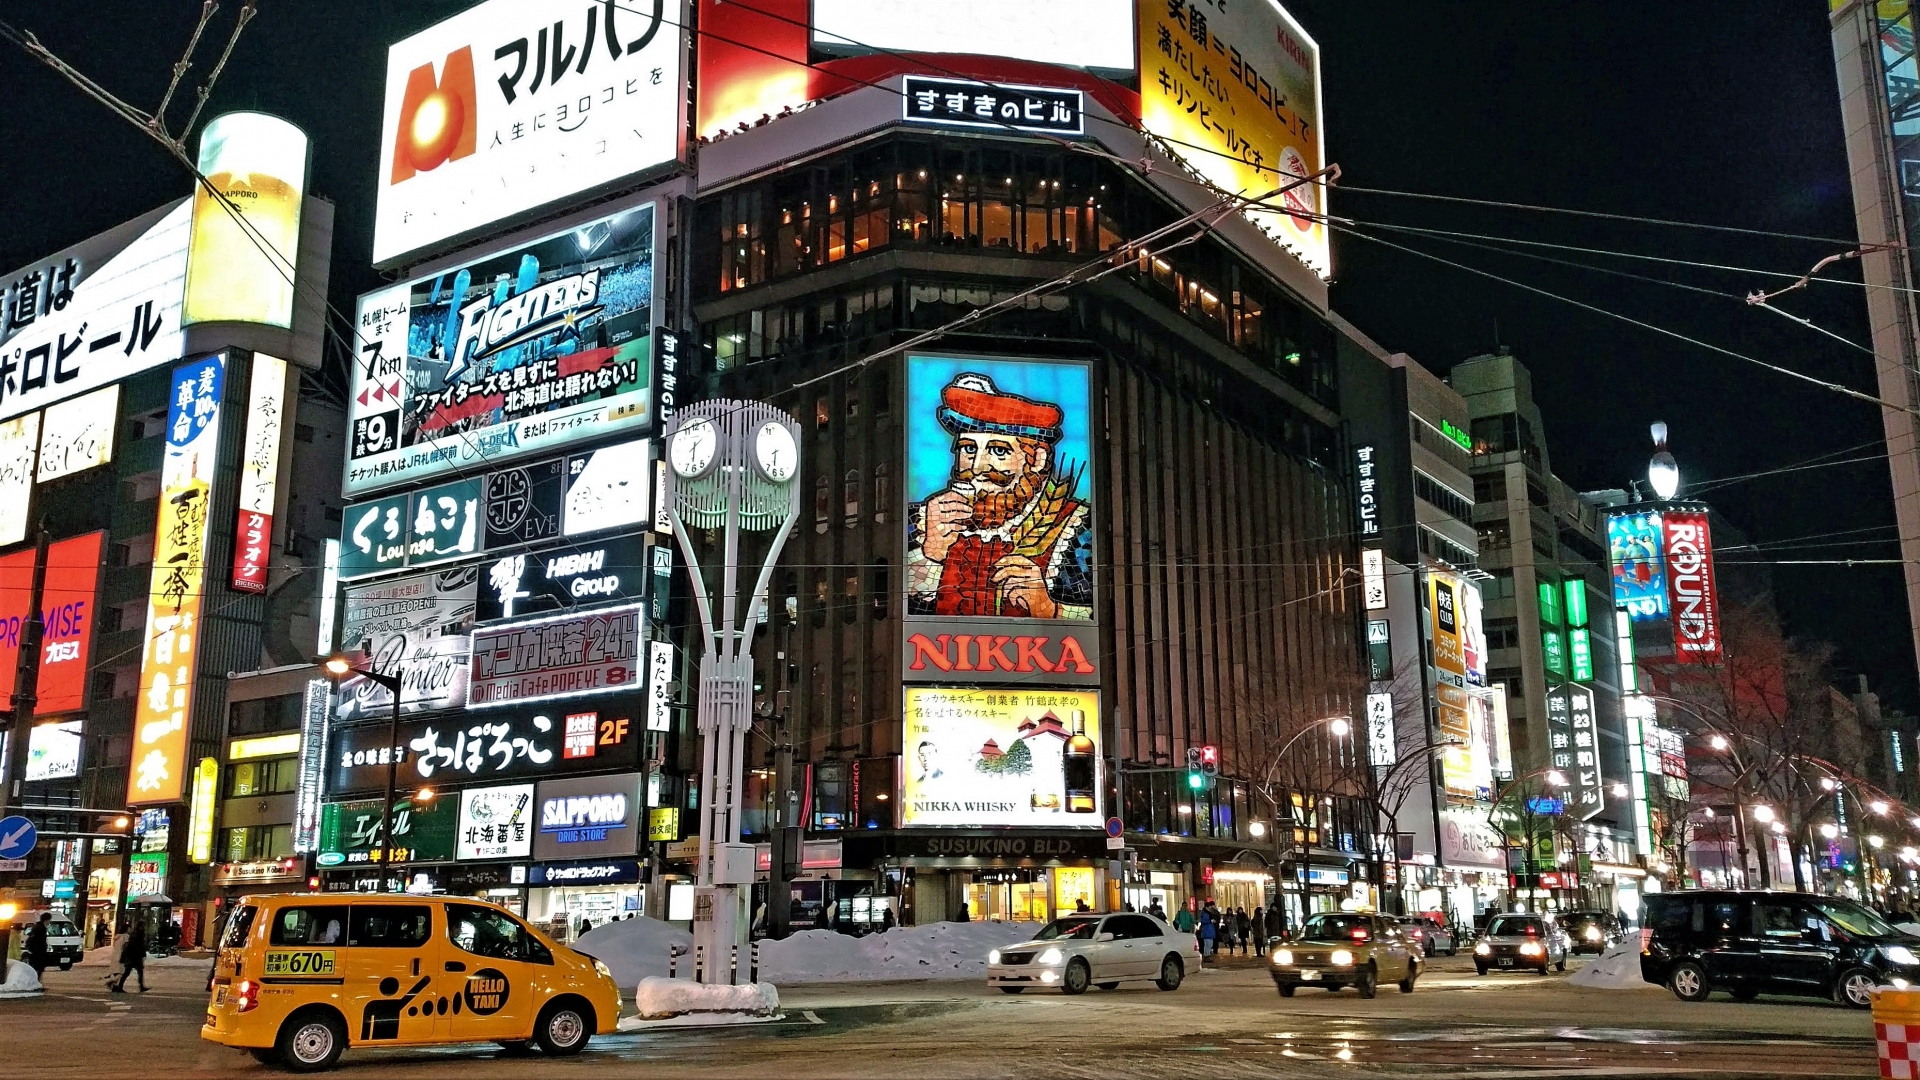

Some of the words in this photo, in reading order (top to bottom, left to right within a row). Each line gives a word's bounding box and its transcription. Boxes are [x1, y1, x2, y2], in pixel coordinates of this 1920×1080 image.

[1276, 25, 1310, 73] KIRIN
[915, 90, 1071, 123] すすきのビル
[0, 258, 78, 334] 道は
[361, 301, 407, 327] 札幌ドーム
[375, 320, 393, 337] まで
[443, 267, 600, 382] FIGHTERS
[362, 341, 402, 381] 7km
[415, 360, 558, 415] ファイターズを見ずに
[173, 379, 196, 443] 革命
[617, 404, 636, 415] 検索
[356, 419, 367, 457] 地下鉄
[523, 422, 547, 440] または
[552, 412, 600, 432] ファイターズ
[350, 444, 458, 482] チケット購入はJR札幌駅前
[569, 457, 585, 475] 2F
[1357, 446, 1378, 534] すすきのビル
[352, 494, 459, 555] くろねこ
[525, 514, 558, 540] EVE
[242, 514, 265, 577] カラオケ
[376, 536, 436, 563] Lounge
[546, 549, 605, 579] HIBIKI
[235, 579, 246, 587] BIG
[246, 580, 264, 590] ECHO
[571, 573, 619, 597] Group
[1701, 563, 1715, 637] ENTERTAINMENT
[0, 601, 85, 649] PRMISE
[1440, 609, 1454, 626] CLUB
[475, 620, 587, 678] マンガ喫茶
[586, 613, 639, 664] 24H
[907, 633, 1097, 674] NIKKA
[1435, 645, 1465, 666] インターネット
[356, 632, 458, 698] Pmier
[486, 679, 519, 700] Media
[521, 676, 548, 697] Cafe
[551, 669, 600, 692] POPEYE
[1025, 695, 1080, 707] 竹鶴政孝の
[410, 715, 552, 777] さっぽろっこ
[599, 718, 629, 745] 2F
[1572, 694, 1598, 805] 第23桂和ビル
[541, 793, 627, 828] SAPPORO
[913, 801, 962, 813] NIKKA
[964, 801, 1017, 813] WHISKY
[351, 810, 411, 847] エイル
[465, 822, 526, 844] 北海番屋
[557, 829, 578, 843] DRUG
[580, 828, 607, 842] STORE
[926, 838, 1026, 855] SUSUKINO
[1033, 838, 1076, 854] BLD.
[237, 866, 265, 876] Susukino
[266, 963, 289, 973] 初乗り
[289, 952, 334, 973] 670円
[267, 954, 290, 963] 普通車
[469, 978, 506, 995] HELLO
[472, 994, 500, 1010] TAXI
